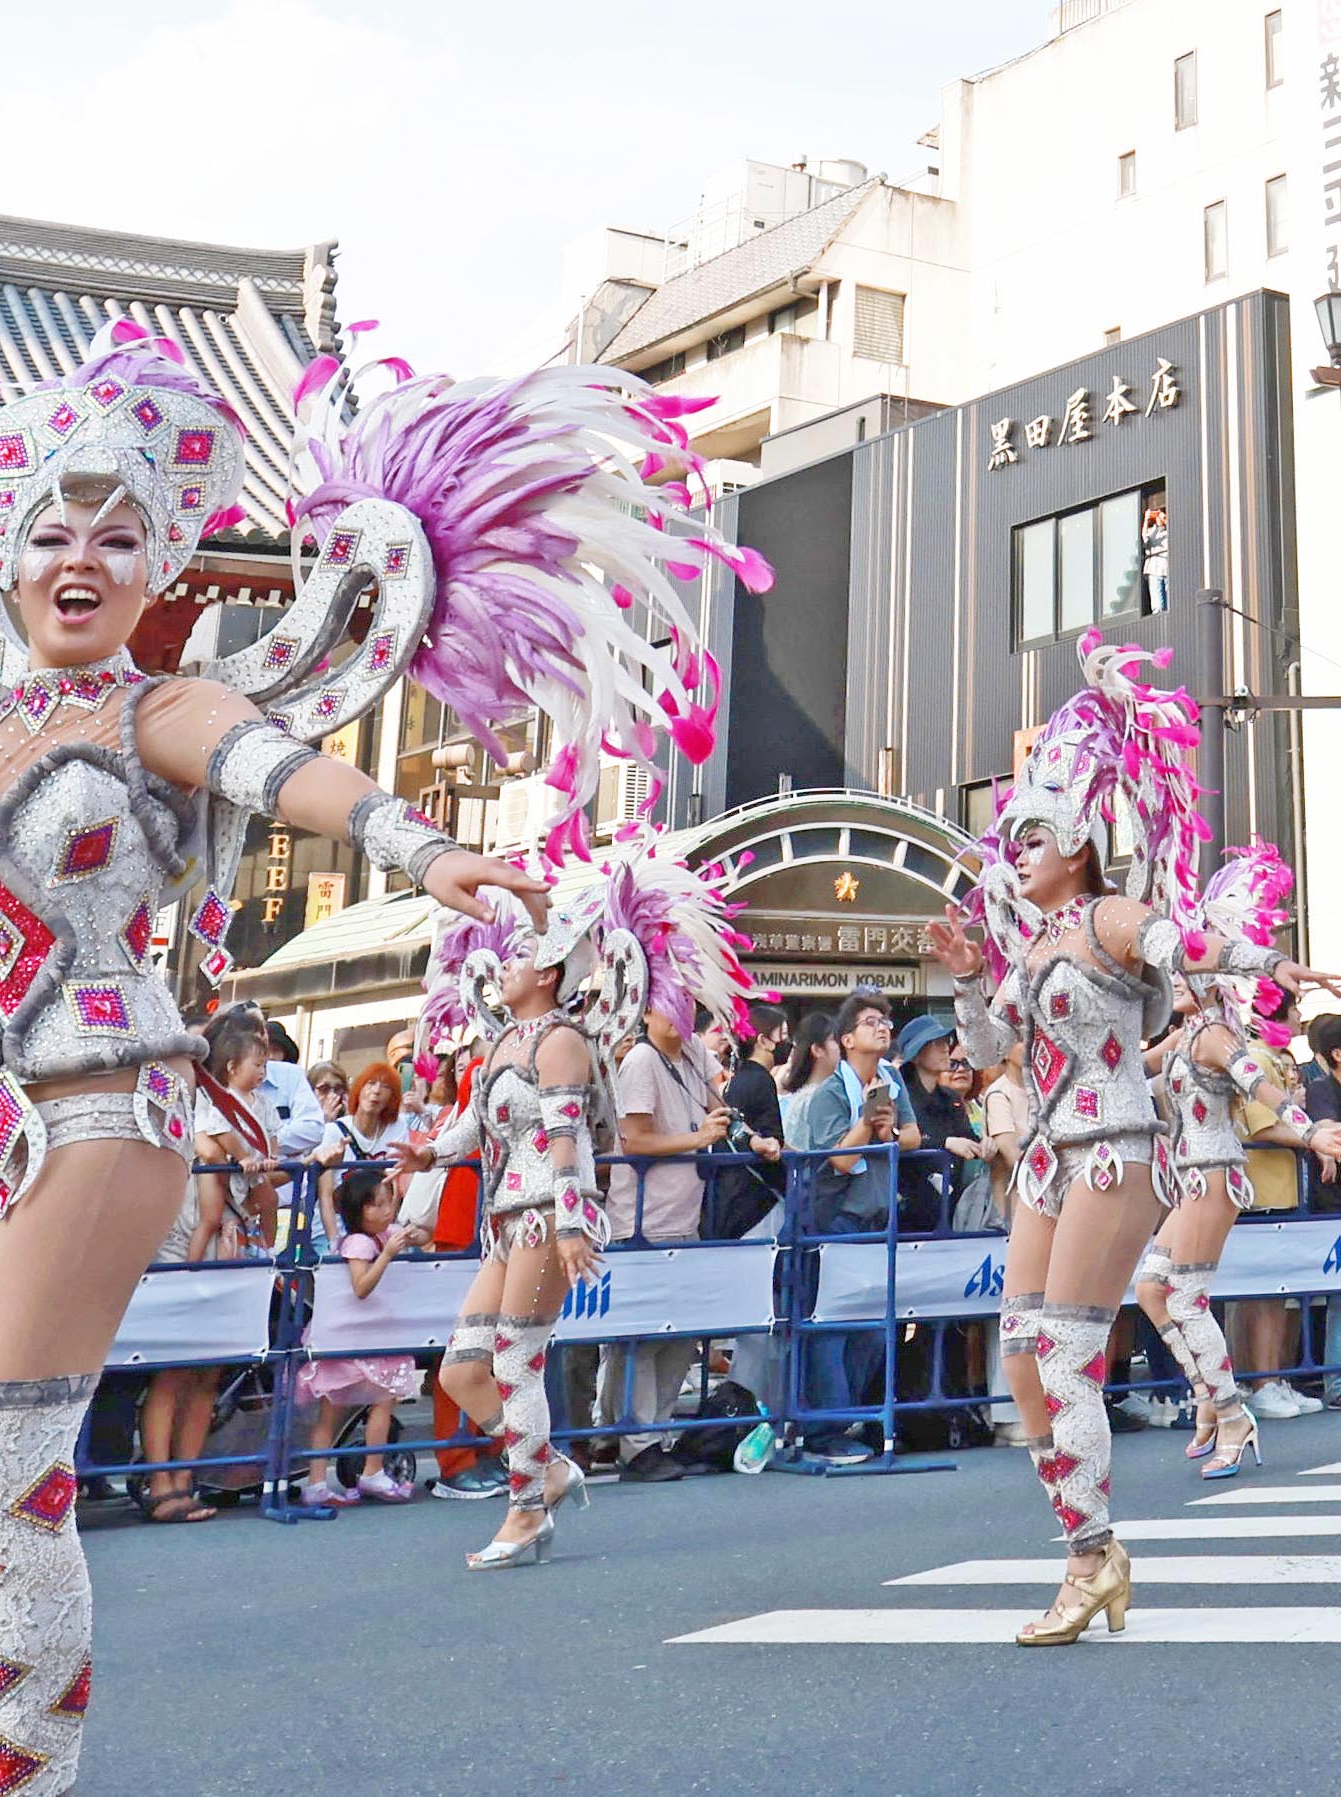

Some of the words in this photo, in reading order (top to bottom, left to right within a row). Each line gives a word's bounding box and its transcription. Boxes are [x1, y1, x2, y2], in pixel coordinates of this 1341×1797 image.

[988, 357, 1180, 471] 黒田屋本店
[261, 821, 290, 922] EEF
[752, 971, 848, 987] AMINARIMON
[856, 972, 906, 989] KOBAN
